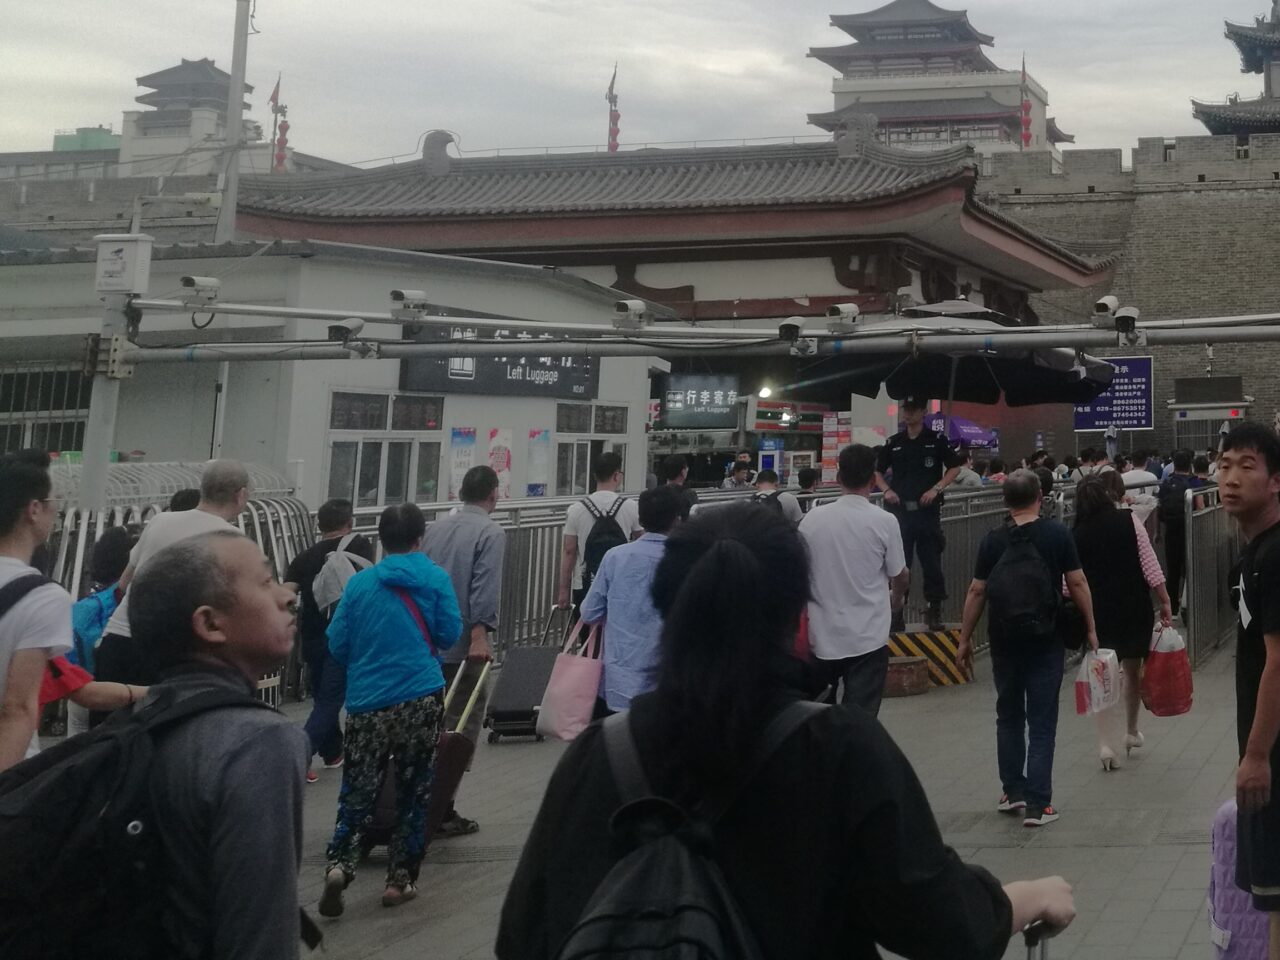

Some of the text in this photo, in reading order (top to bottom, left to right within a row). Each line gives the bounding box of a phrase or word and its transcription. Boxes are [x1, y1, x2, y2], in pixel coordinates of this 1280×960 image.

[507, 364, 559, 385] Left Luggage
[686, 389, 738, 405] 行李寄存
[707, 406, 730, 414] Luggage
